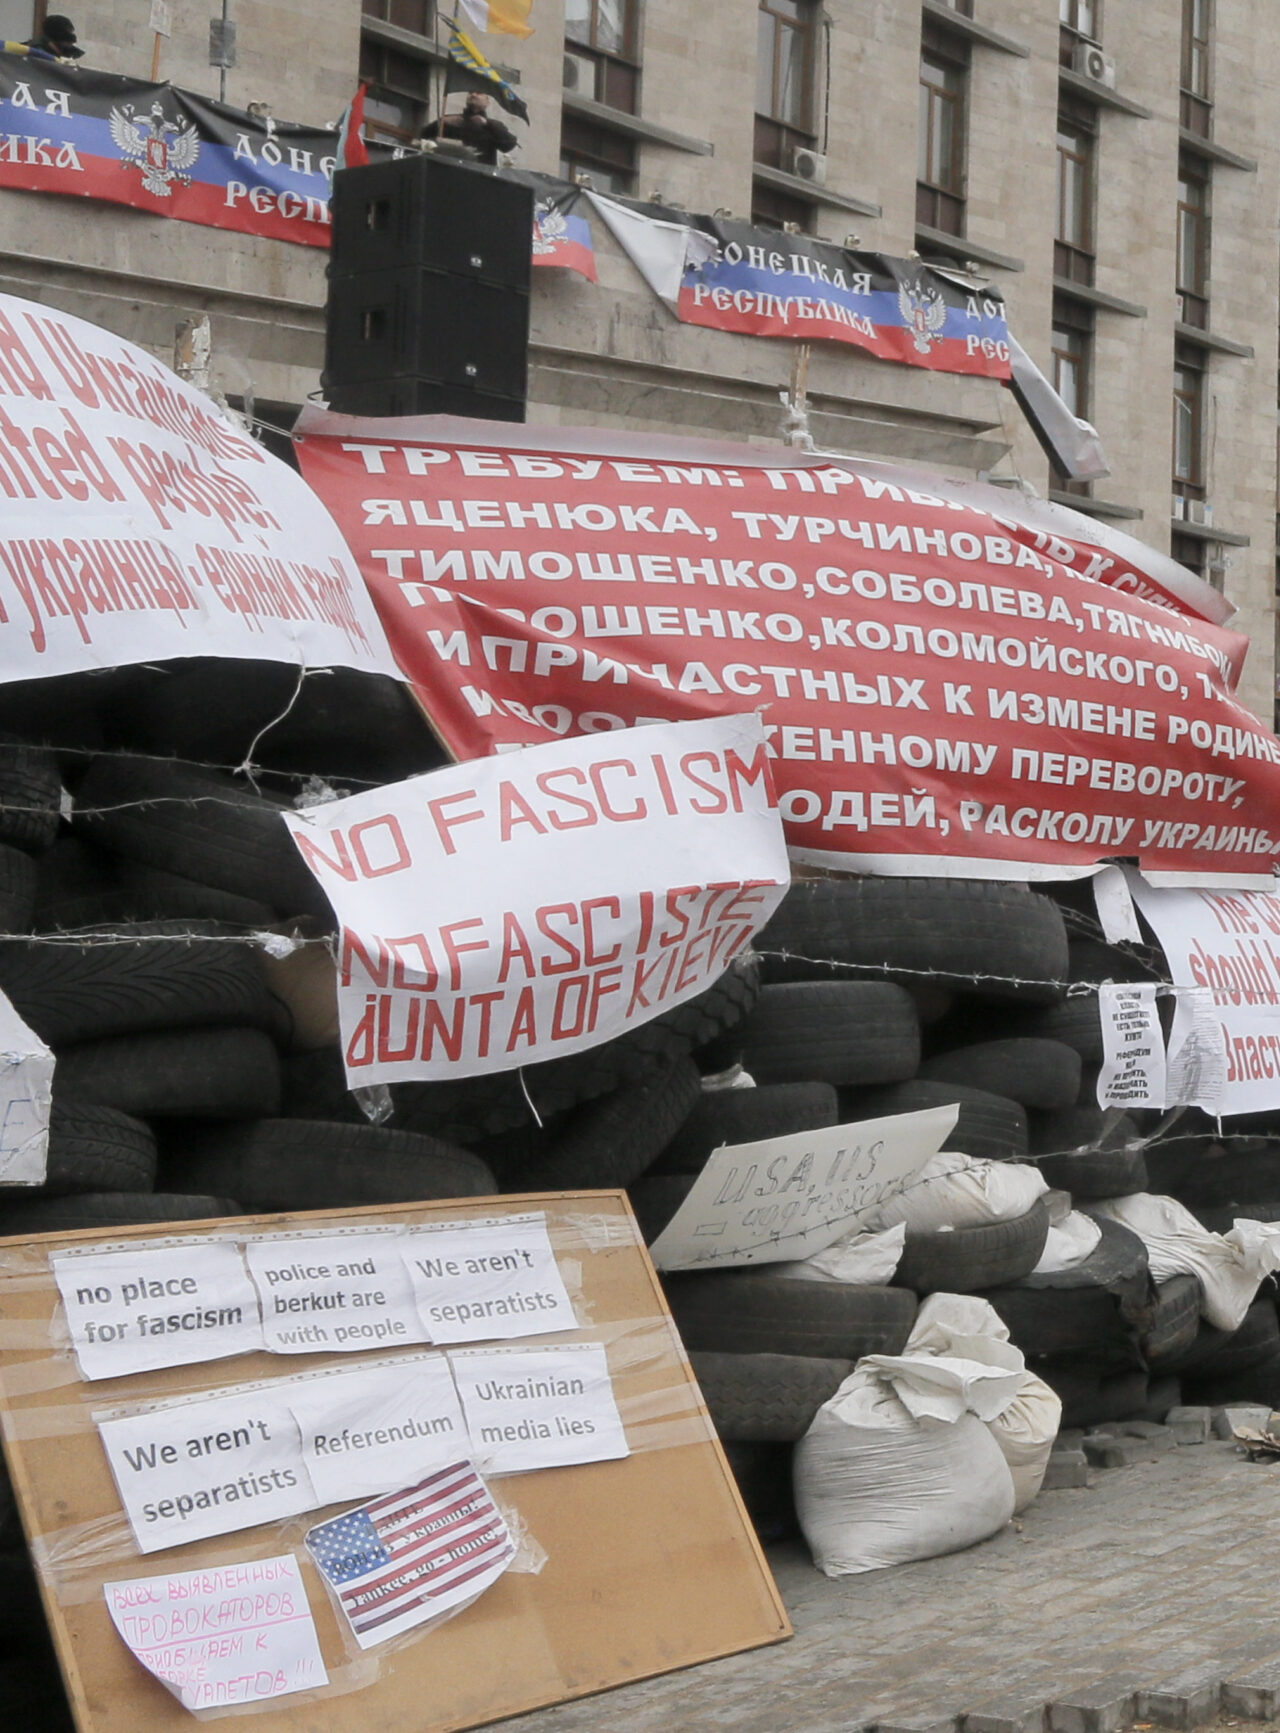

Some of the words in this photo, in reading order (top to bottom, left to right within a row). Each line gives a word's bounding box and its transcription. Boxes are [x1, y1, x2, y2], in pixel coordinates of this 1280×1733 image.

[9, 81, 73, 119] АЯ
[0, 132, 85, 171] ИКА
[233, 132, 337, 181] ДОНЕ
[223, 180, 332, 224] РЕСП
[719, 241, 872, 296] ОНЕЦКАЯ
[693, 283, 878, 339] РЕСПУБЛИКА
[966, 334, 1010, 362] РЕС
[21, 311, 265, 464] Ukrainians
[0, 404, 127, 502] ited
[106, 436, 282, 543] people!
[341, 443, 746, 487] ТРЕБУЕМ:
[361, 499, 718, 541] ЯЦЕНЮКА,
[732, 511, 1054, 579] ТУРЧИНОВА,
[0, 538, 199, 653] украинцы
[426, 629, 471, 666] И
[481, 635, 930, 710] ПРИЧАСТНЫХ
[943, 682, 974, 716] К
[987, 688, 1157, 741] ИЗМЕНЕ
[1011, 748, 1247, 810] ПЕРЕВОРОТУ,
[293, 813, 412, 883] NO
[427, 743, 780, 856] FASCISM
[960, 800, 1135, 846] РАСКОЛУ
[341, 925, 439, 993] NO
[1188, 938, 1280, 1007] should
[551, 964, 623, 1042] OF
[265, 1262, 332, 1287] police
[336, 1257, 376, 1279] and
[416, 1258, 460, 1280] We
[465, 1248, 535, 1274] aren't
[76, 1282, 111, 1305] no
[121, 1274, 197, 1307] place
[273, 1290, 346, 1315] berkut
[351, 1289, 386, 1308] are
[430, 1290, 558, 1325] separatists
[84, 1320, 132, 1345] for
[136, 1304, 243, 1337] fascism
[276, 1323, 330, 1347] with
[334, 1317, 406, 1345] people
[475, 1374, 584, 1402] Ukrainian
[123, 1443, 178, 1473] We
[185, 1418, 272, 1459] aren't
[313, 1414, 454, 1456] Referendum
[480, 1419, 550, 1444] media
[556, 1414, 595, 1438] lies
[142, 1465, 298, 1525] separatists
[168, 1562, 293, 1601] ВЫЯВЛЕННЫХ
[122, 1592, 294, 1644] ПРОВОКАТОРОВ
[256, 1632, 267, 1650] К
